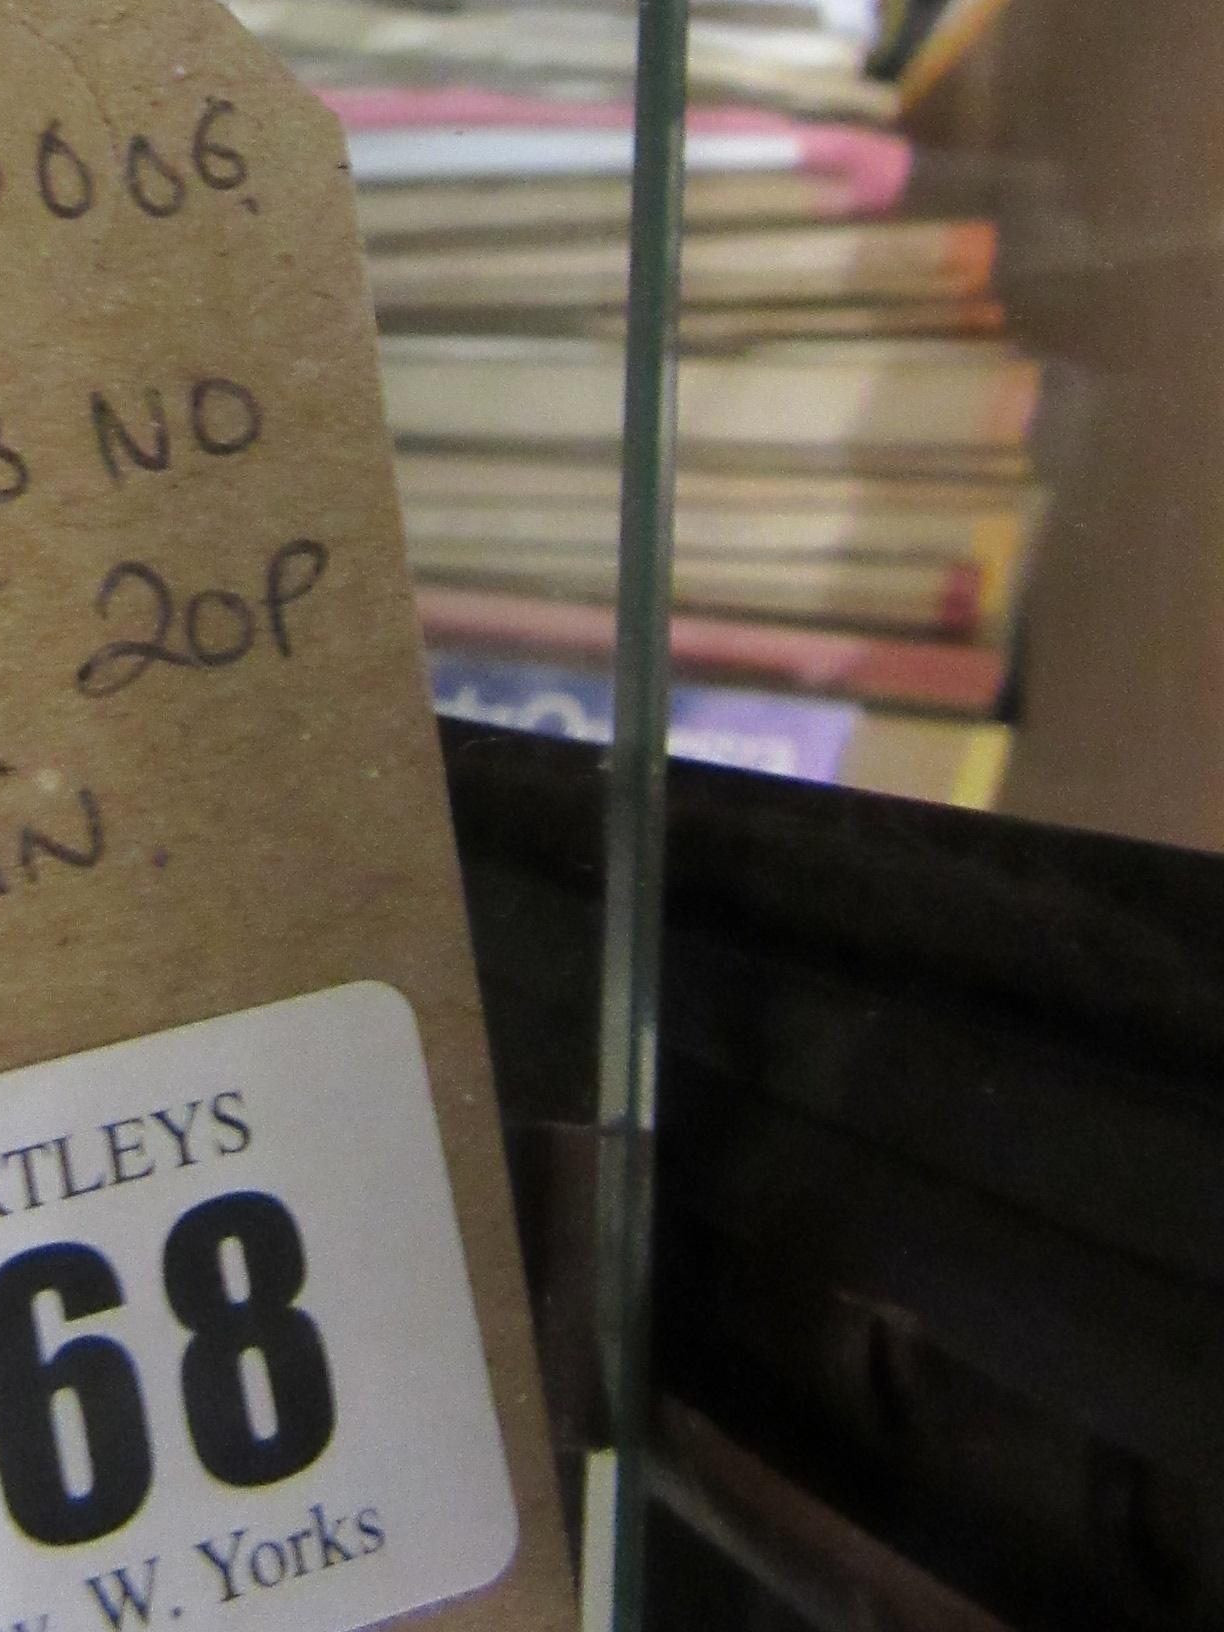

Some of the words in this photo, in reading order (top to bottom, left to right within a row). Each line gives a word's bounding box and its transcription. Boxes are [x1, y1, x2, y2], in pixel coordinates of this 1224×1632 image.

[90, 377, 263, 482] NO
[85, 1555, 183, 1631] W.
[194, 1504, 387, 1602] Yorks
